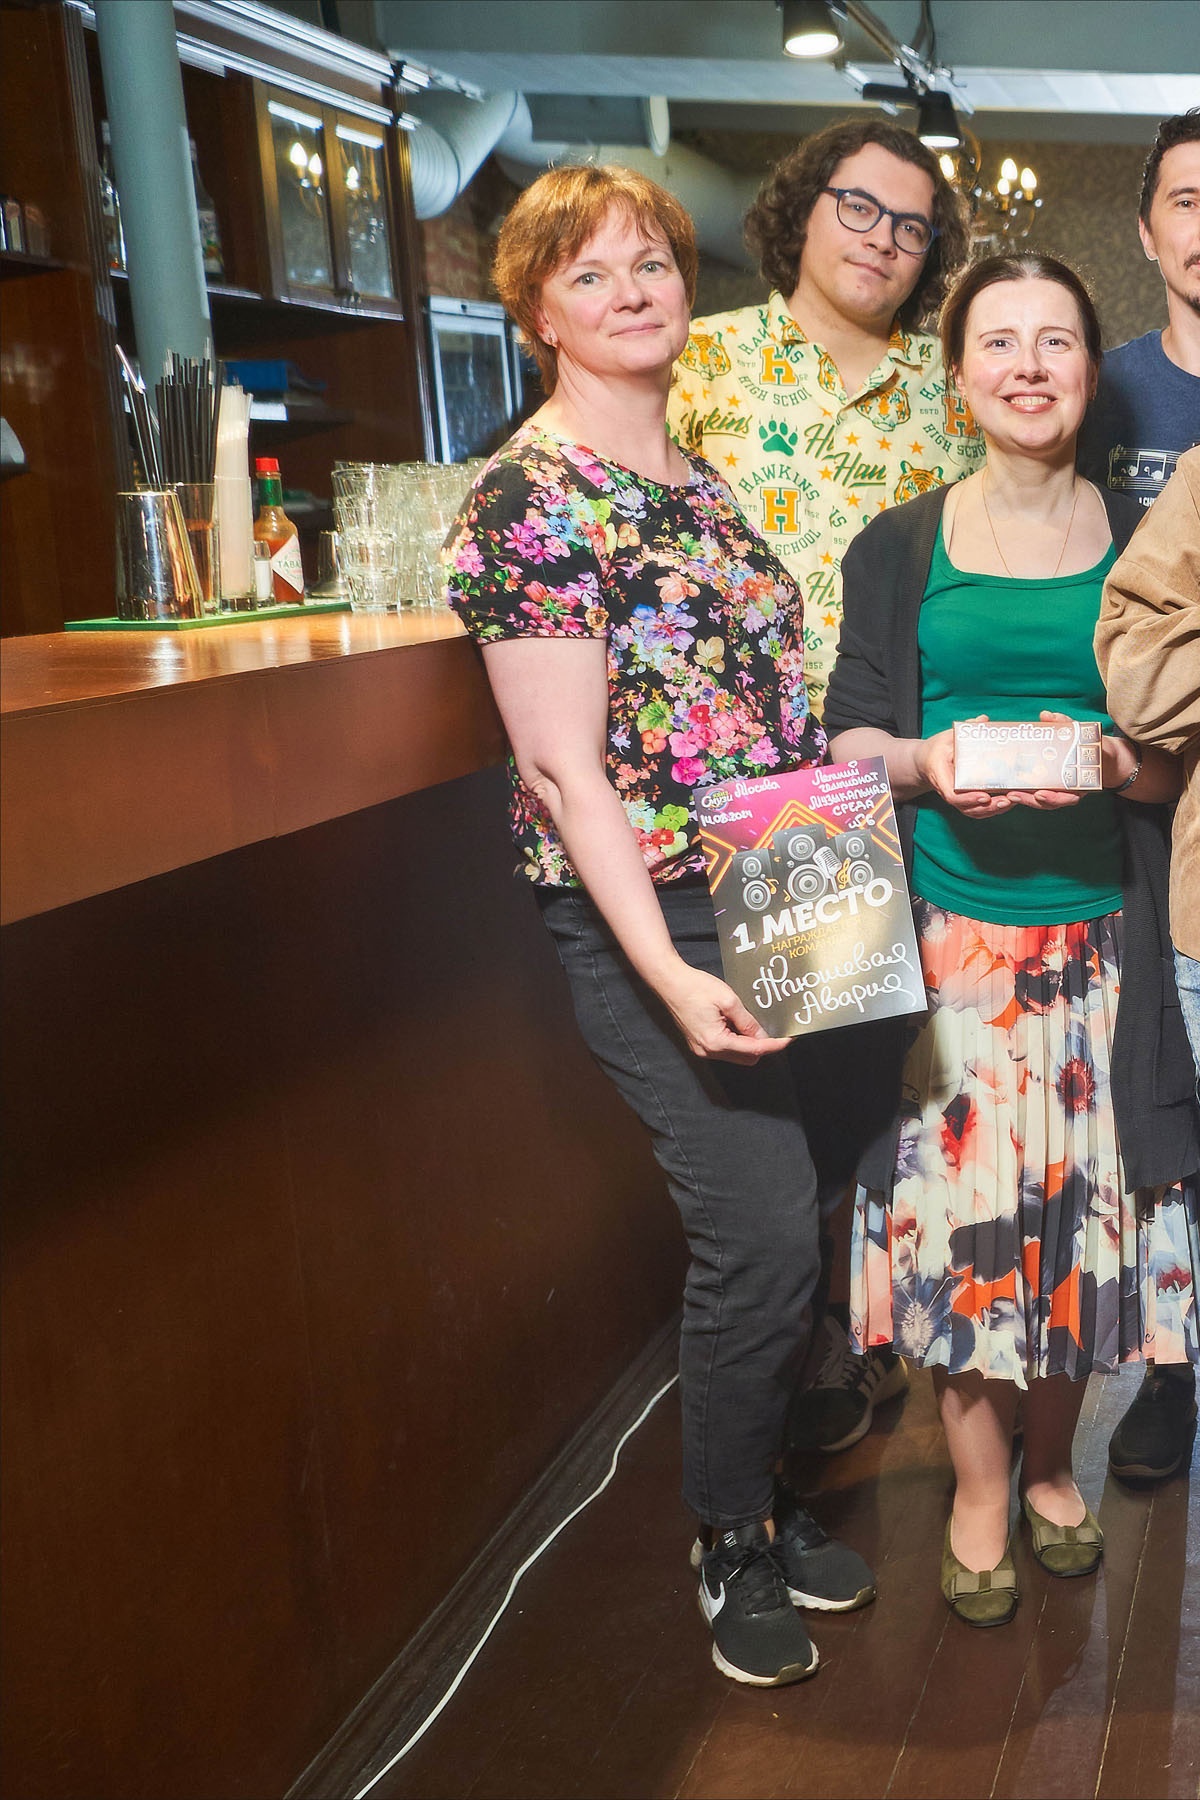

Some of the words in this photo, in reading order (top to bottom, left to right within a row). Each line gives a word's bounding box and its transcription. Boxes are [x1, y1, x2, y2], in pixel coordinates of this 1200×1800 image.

[922, 423, 953, 452] HIGH
[738, 463, 820, 501] HAWKINS
[760, 487, 801, 535] H
[775, 529, 821, 556] SCHOOL
[805, 661, 823, 670] 1952
[959, 723, 1055, 744] Schogetten
[733, 922, 756, 953] 1
[762, 877, 893, 945] МЕСТО
[794, 973, 916, 1025] Авария
